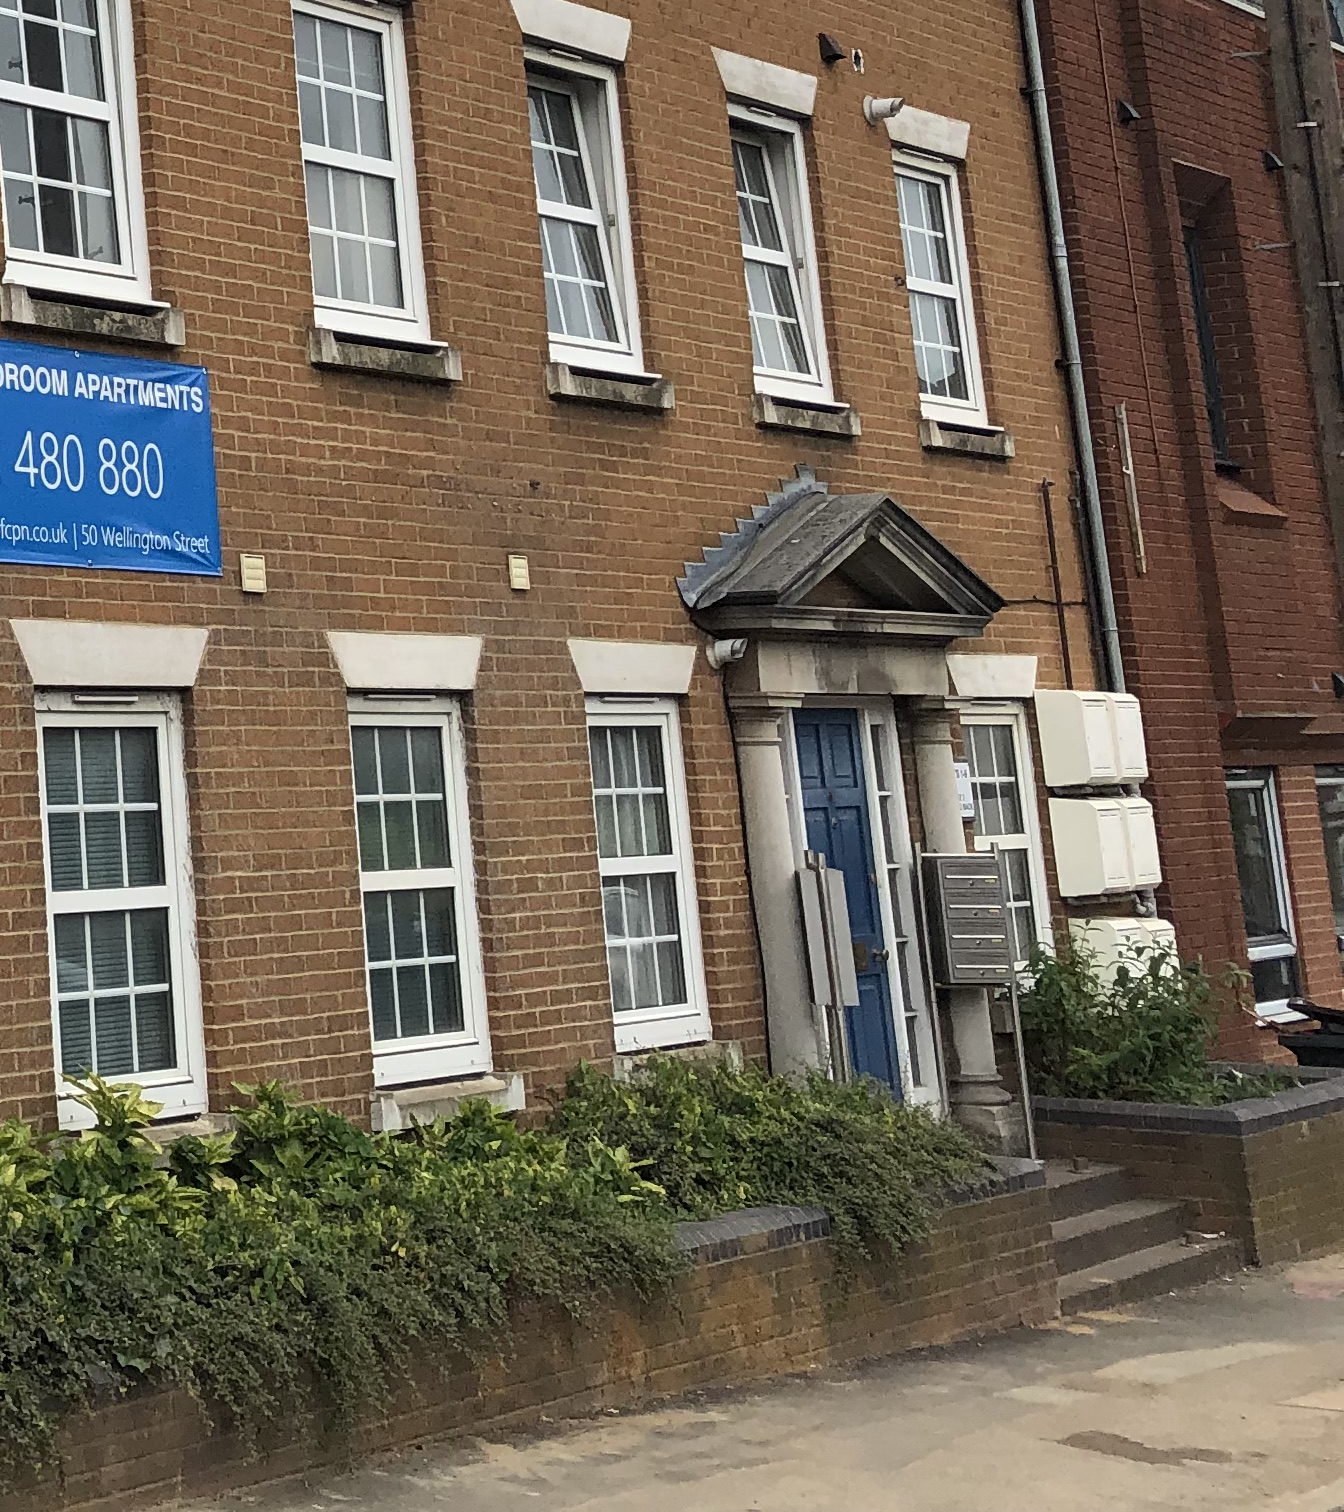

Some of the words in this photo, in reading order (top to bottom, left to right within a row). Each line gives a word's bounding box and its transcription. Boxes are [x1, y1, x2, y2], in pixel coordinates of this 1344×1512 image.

[74, 371, 204, 414] APARTMENTS
[14, 430, 85, 493] 480
[98, 437, 164, 500] 880
[81, 524, 98, 546] 50
[100, 525, 172, 555] Wellington
[173, 530, 211, 554] Street
